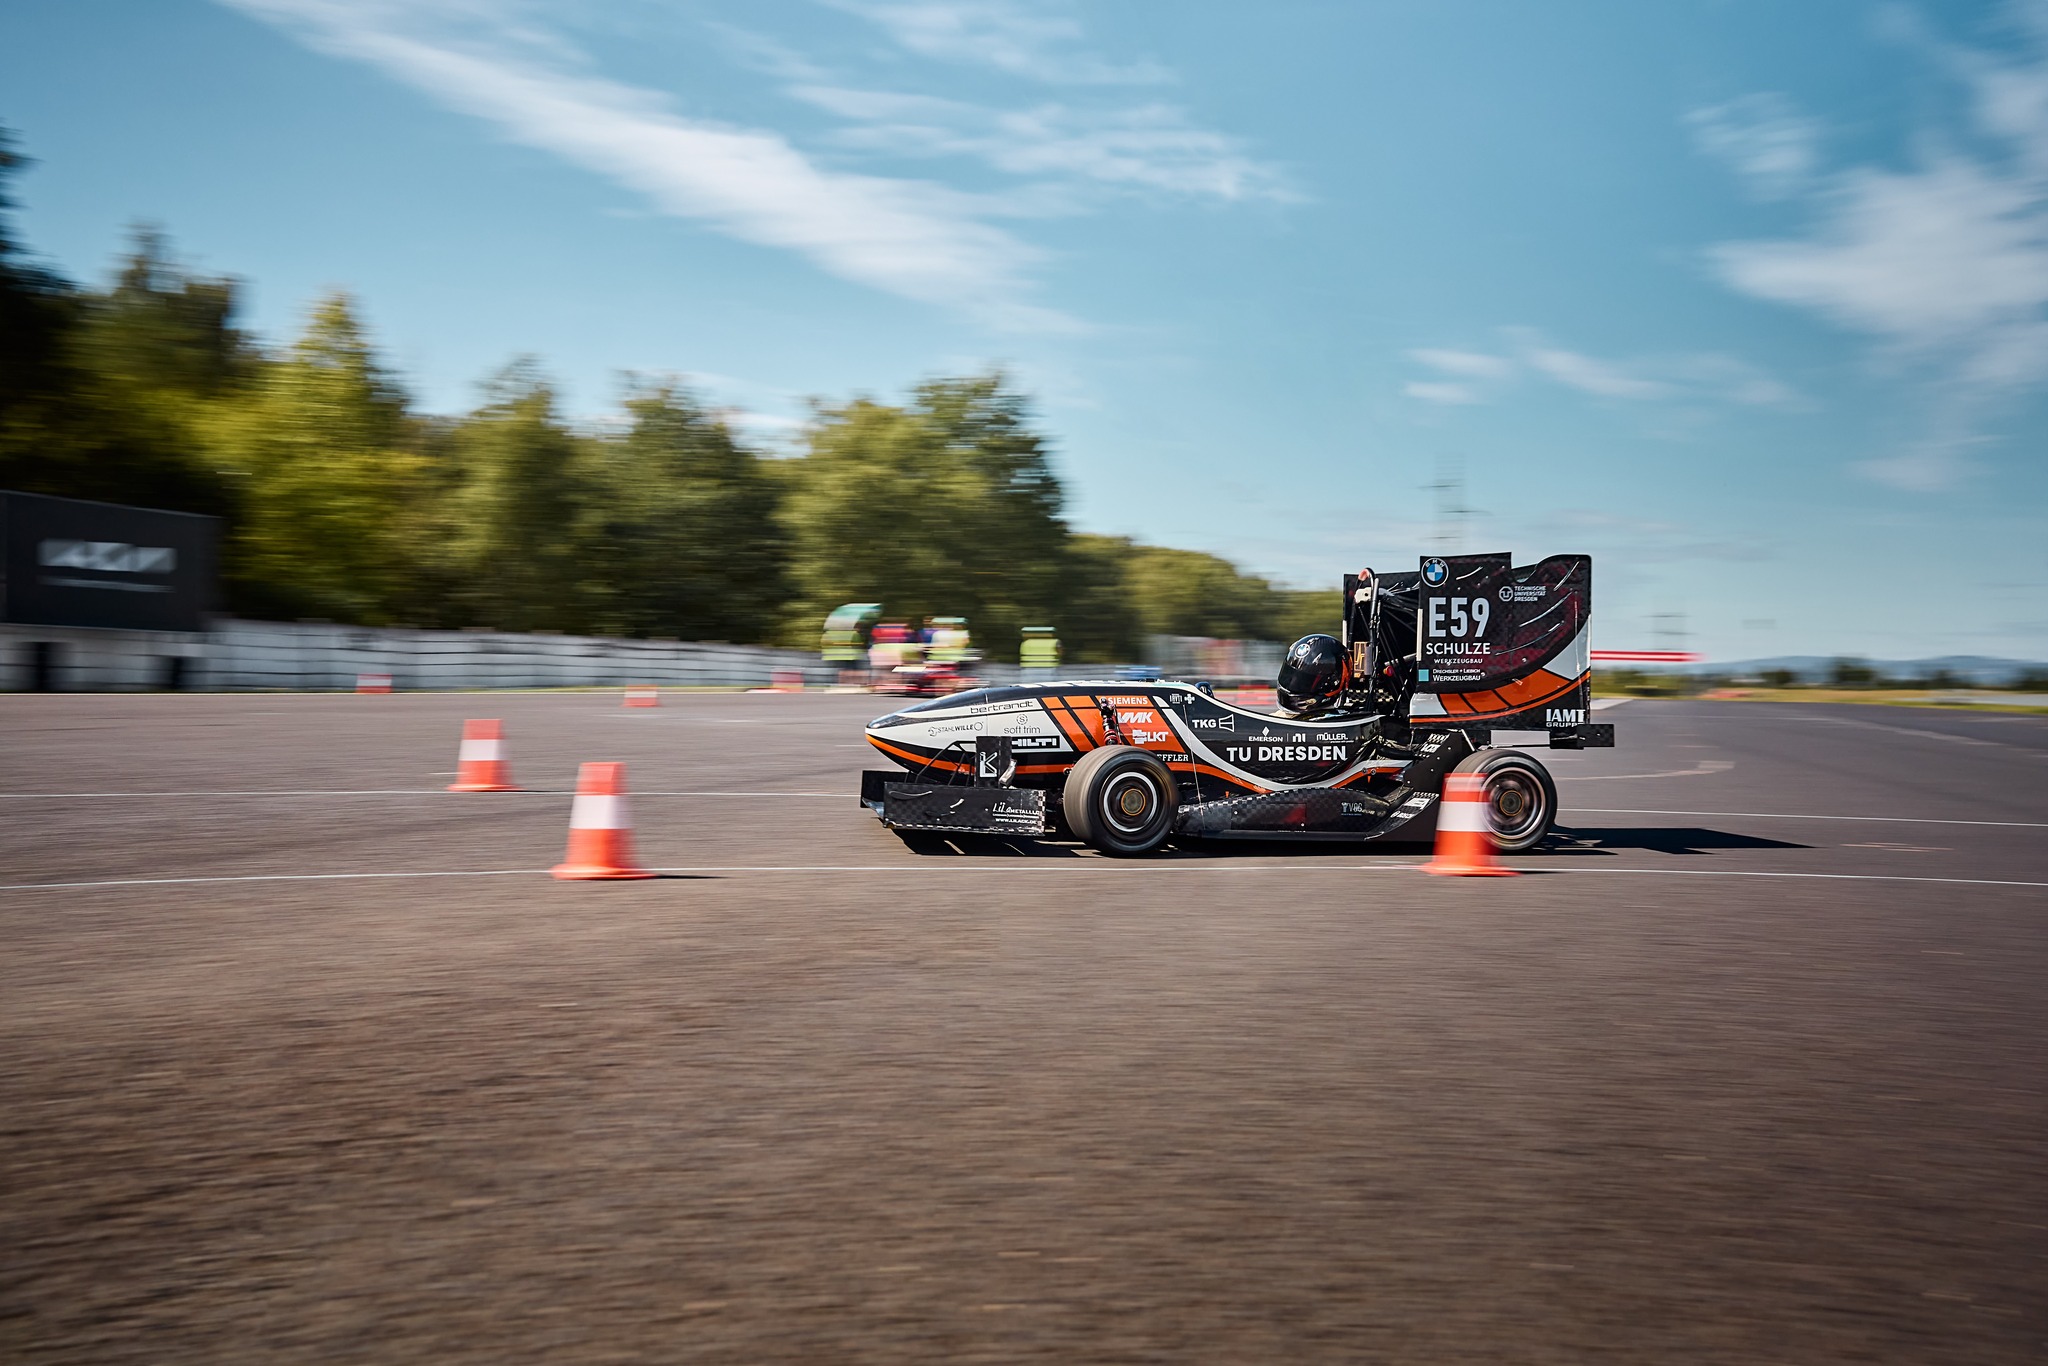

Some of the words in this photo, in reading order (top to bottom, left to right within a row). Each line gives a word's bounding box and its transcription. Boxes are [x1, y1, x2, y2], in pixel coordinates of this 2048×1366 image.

[1429, 597, 1490, 637] E59
[1426, 643, 1491, 655] SCHULZE
[1107, 697, 1149, 705] SIEMENS
[970, 701, 1034, 714] bertrandt
[1546, 708, 1586, 723] IAMT
[1192, 719, 1217, 729] TKG
[1004, 726, 1023, 734] soft
[1023, 726, 1041, 734] trim
[1147, 731, 1169, 742] LKT
[1157, 754, 1189, 762] FFLER
[1226, 746, 1252, 762] TU
[1258, 745, 1348, 762] DRESDEN
